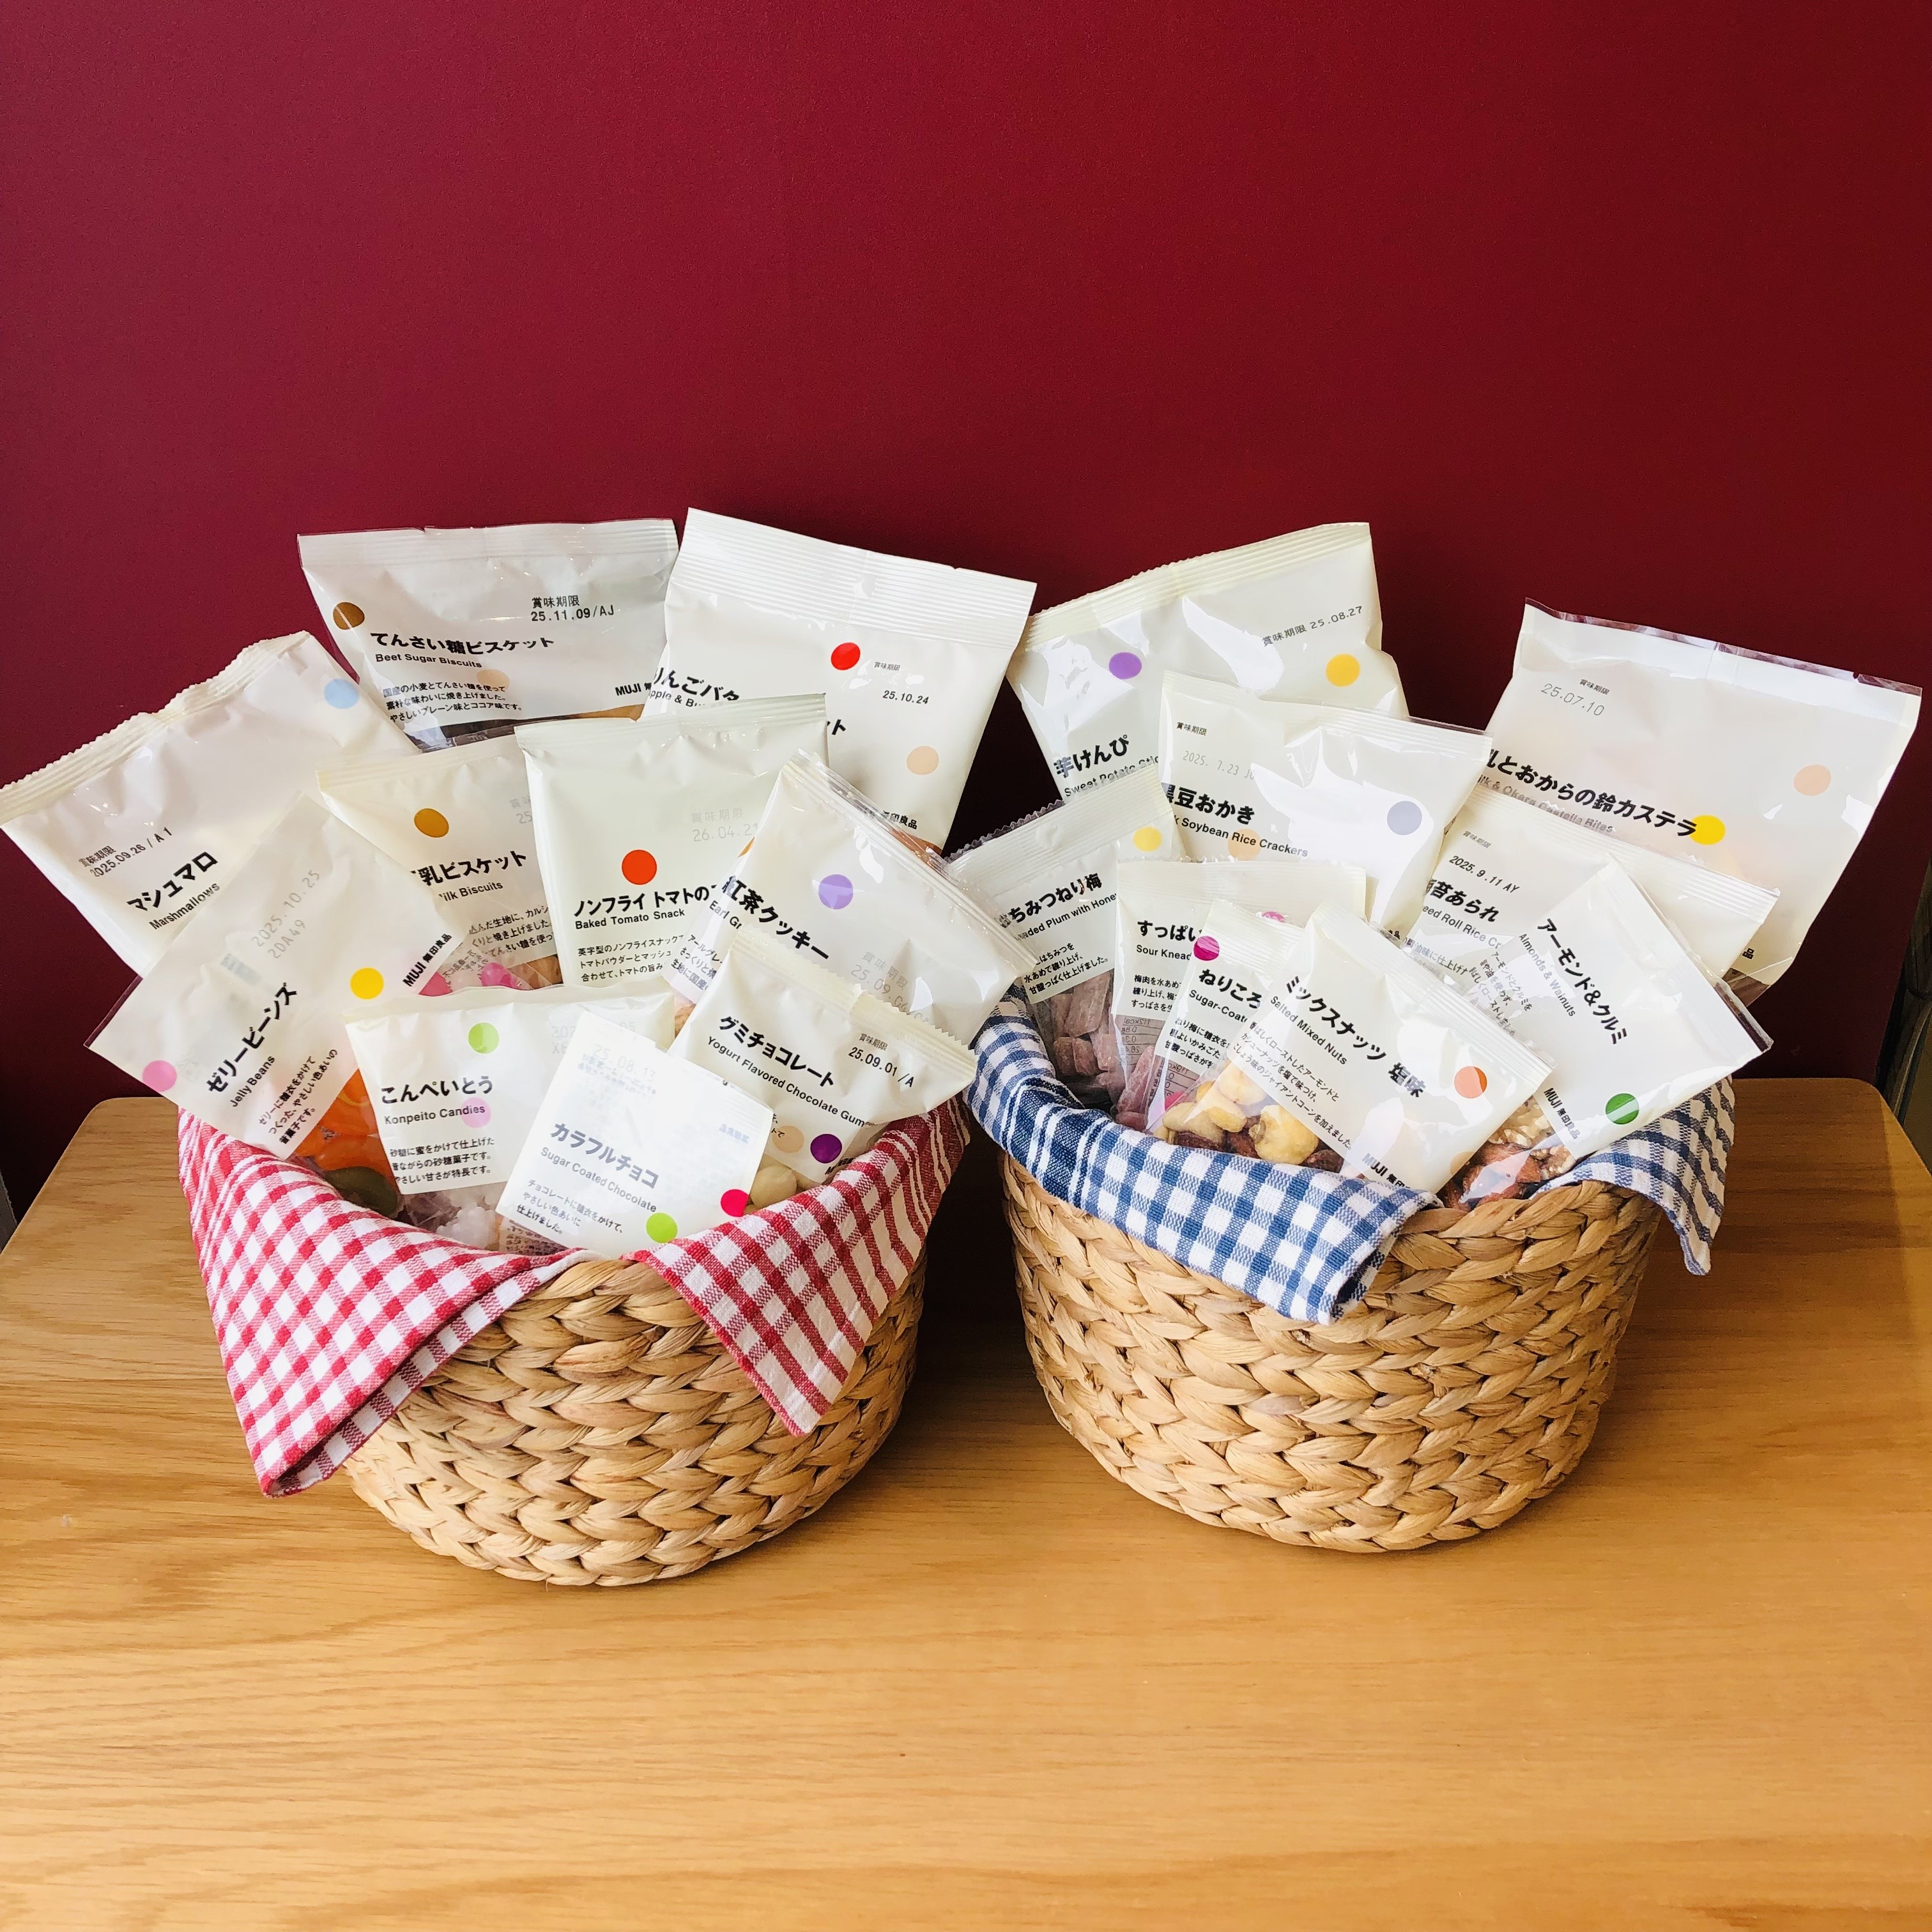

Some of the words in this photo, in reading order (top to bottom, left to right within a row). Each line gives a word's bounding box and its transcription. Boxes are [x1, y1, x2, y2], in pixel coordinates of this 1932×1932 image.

[530, 604, 615, 622] 25.11.09/AJ
[532, 595, 580, 609] 賞味期限
[1261, 624, 1307, 647] 賞味期限
[1310, 606, 1363, 630] 25.08.27
[370, 632, 555, 655] てんさい糖ビスケット
[376, 654, 402, 663] Beet
[404, 654, 436, 664] Sugar
[439, 657, 482, 668] Biscuits
[874, 661, 901, 671] 賞味期限
[615, 683, 641, 696] MUJI
[648, 690, 671, 701] pple
[882, 690, 930, 705] 25.10.24
[1540, 682, 1605, 717] 25.07.10
[1579, 678, 1610, 696] 賞味期限
[1176, 721, 1207, 736] 賞味期限
[1054, 734, 1129, 778] 芋けんぴ
[1181, 817, 1229, 839] Soybean
[1231, 832, 1257, 846] Rice
[1259, 839, 1308, 857] Crackers
[79, 845, 116, 867] 賞味期限
[410, 850, 526, 886] 乳ビスケット
[126, 852, 218, 911] マシュマロ
[459, 881, 503, 897] Biscuits
[654, 884, 717, 908] トマトの
[149, 883, 220, 930] Marshmallows
[709, 900, 730, 919] Earl
[1426, 879, 1499, 922] 苔あられ
[576, 918, 607, 930] Baked
[611, 914, 649, 925] Tomato
[654, 908, 685, 920] Snack
[721, 874, 829, 960] 紅茶クッキー
[1046, 912, 1071, 929] Plum
[1071, 905, 1091, 919] with
[1441, 913, 1464, 928] Roll
[1463, 924, 1486, 942] Rice
[402, 962, 426, 986] MUJI
[422, 933, 452, 963] 無印良品
[687, 934, 723, 964] アールグレ
[1036, 942, 1075, 965] はちみつを
[1136, 945, 1158, 956] Sour
[671, 958, 708, 990] 生地に国産
[1134, 974, 1181, 989] 梅肉を水あめ
[1519, 933, 1546, 972] Almonds
[1550, 979, 1575, 1016] Walnuts
[1133, 986, 1177, 1000] 練り上げ、梅
[206, 982, 297, 1092] ゼリービーンズ
[859, 1033, 888, 1052] 賞味期限
[1175, 1017, 1230, 1049] ねり梅に糖衣を
[1270, 996, 1298, 1023] Salted
[1297, 1020, 1326, 1046] Mixed
[1324, 1043, 1348, 1065] Nuts
[719, 1016, 834, 1088] グミチョコレート
[231, 1085, 252, 1107] Jelly
[249, 1055, 275, 1086] Beans
[381, 1075, 493, 1104] こんぺいとう
[707, 1036, 741, 1062] Yogurt
[741, 1059, 786, 1089] Flavored
[786, 1083, 838, 1115] Chocolate
[840, 1109, 866, 1128] Gum
[385, 1111, 436, 1124] Konpeito
[440, 1105, 486, 1118] Candies
[1544, 1087, 1563, 1108] MUJI
[1557, 1108, 1580, 1140] 無印良品
[390, 1137, 495, 1157] 砂糖に蜜をかけて仕上げた
[550, 1123, 659, 1189] カラフルチョコ
[1361, 1153, 1388, 1177] MUJI
[541, 1147, 571, 1168] Sugar
[572, 1163, 608, 1187] Coated
[607, 1181, 657, 1213] Chocolate
[516, 1204, 563, 1234] 仕上げました。
[523, 1192, 581, 1227] やさしい色あいに
